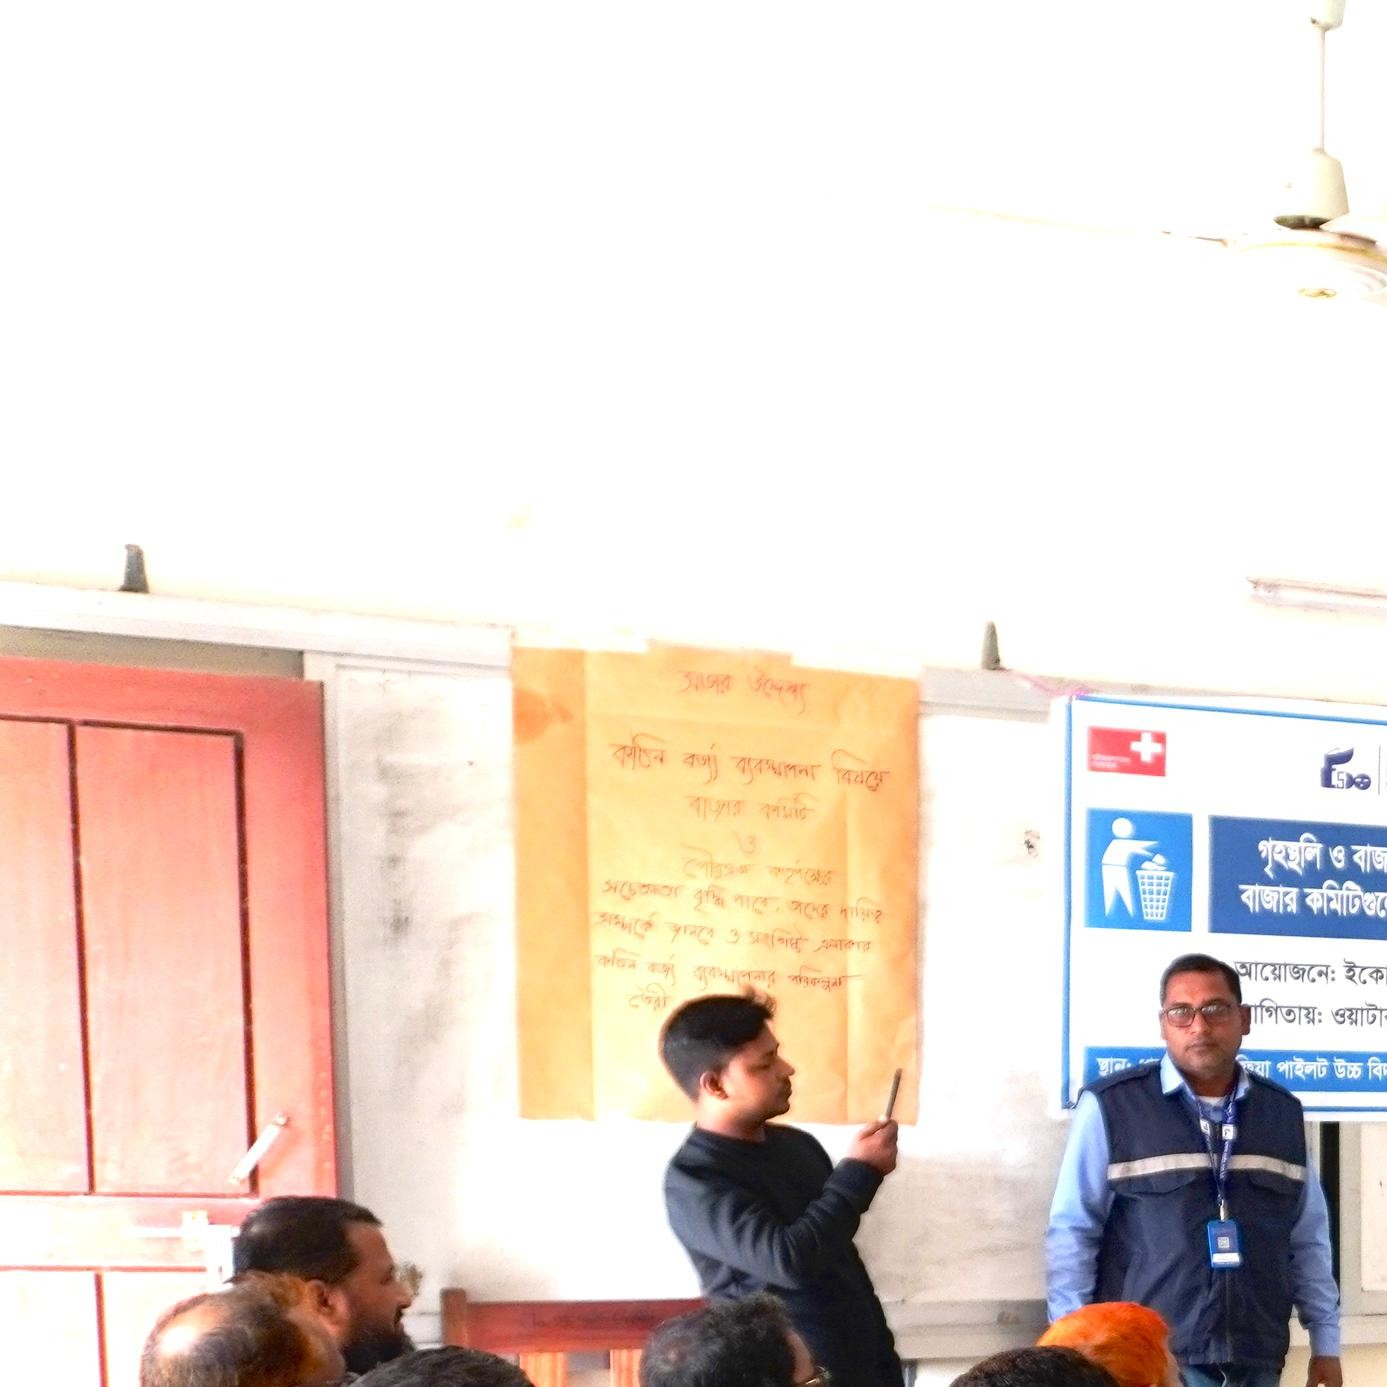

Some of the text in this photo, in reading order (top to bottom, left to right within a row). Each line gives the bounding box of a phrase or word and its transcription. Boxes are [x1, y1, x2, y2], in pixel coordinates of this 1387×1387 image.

[1258, 832, 1324, 880] গৃহস্থলি
[1329, 843, 1345, 869] ও
[1238, 883, 1300, 914] বাজার
[1276, 1055, 1329, 1081] পাইলট
[1333, 1057, 1362, 1081] উচ্চ
